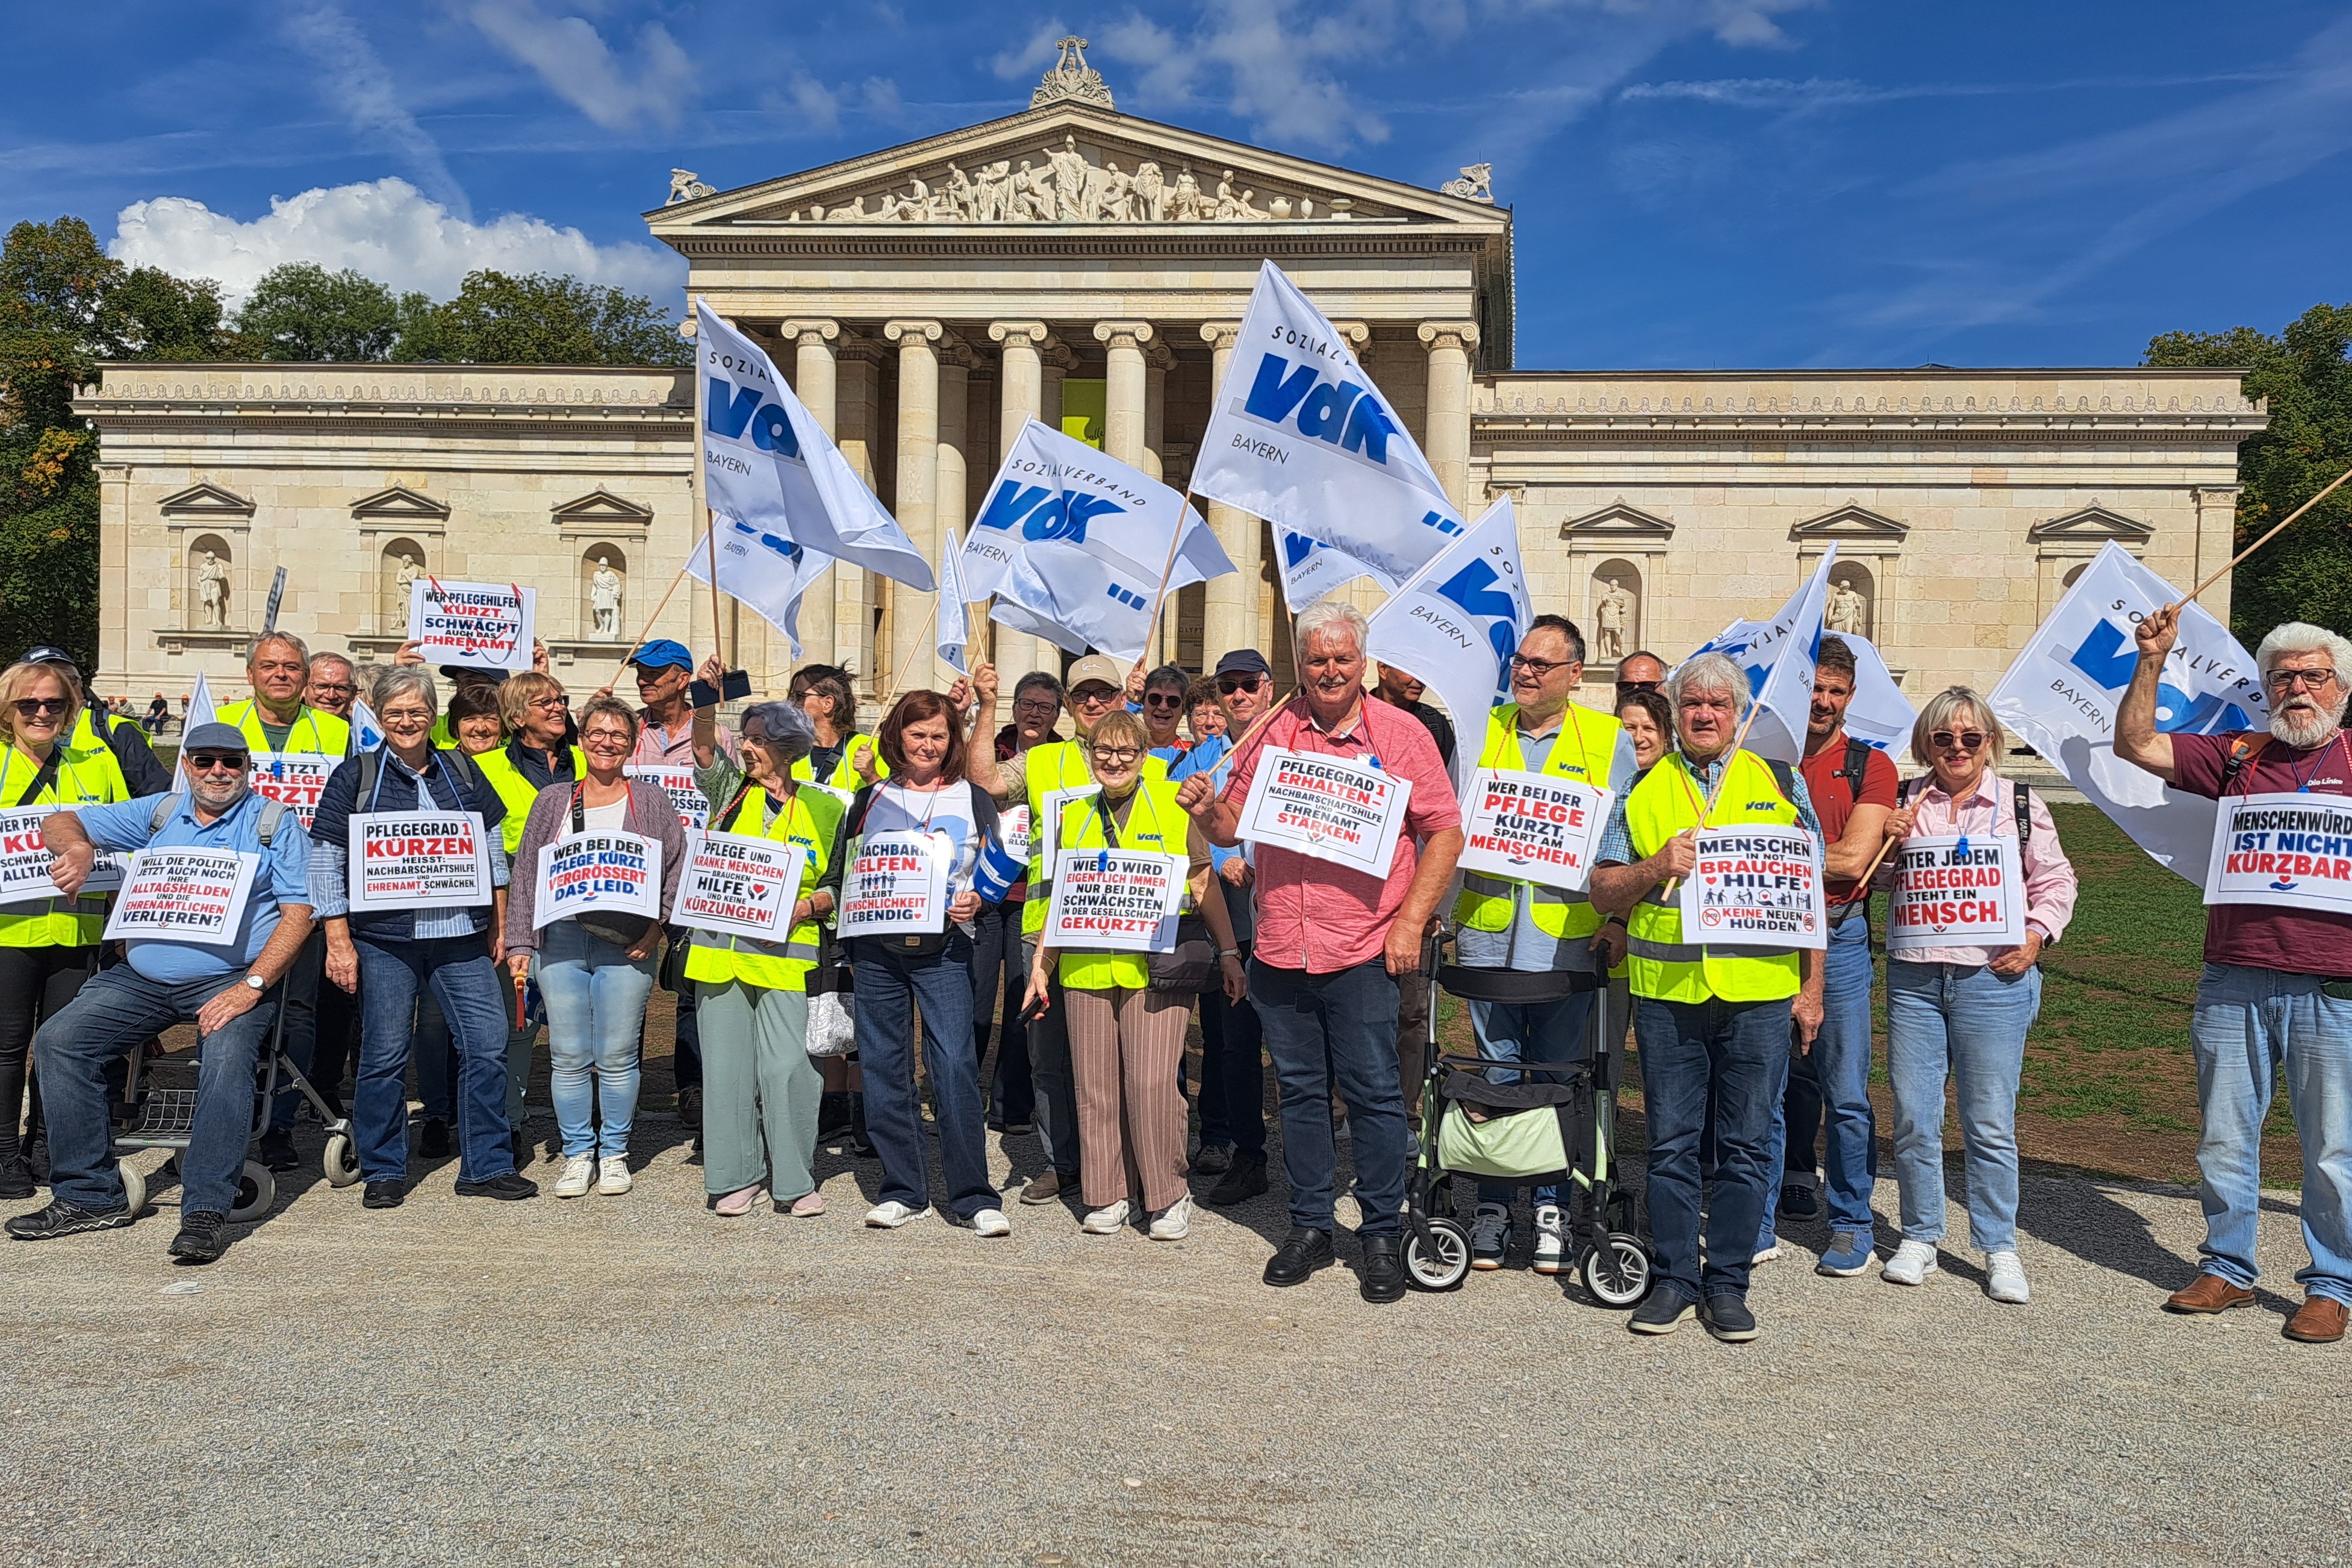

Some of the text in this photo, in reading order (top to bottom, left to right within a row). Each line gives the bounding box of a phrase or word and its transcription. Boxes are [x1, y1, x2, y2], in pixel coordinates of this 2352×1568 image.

[1231, 433, 1289, 465] BAYERN
[708, 450, 752, 477] BAYERN
[1012, 459, 1146, 506] SOZIALVERBAND
[966, 542, 1013, 564] BAYERN
[1290, 558, 1324, 585] BAYERN
[426, 591, 521, 608] WER PFLEGEHILFEN
[443, 604, 505, 618] KÜRZT.
[425, 617, 518, 634] SCHWÄCHT
[1409, 606, 1473, 649] BAYERN
[423, 635, 518, 651] EHRENAMT.
[2050, 679, 2112, 734] BAYERN
[1558, 762, 1587, 775] VdK
[664, 775, 696, 789] HIL
[1279, 760, 1385, 797] PFLEGEGRAD 1
[1277, 772, 1370, 805] ERHALTEN
[1487, 780, 1581, 808] WER BEI DER
[1268, 786, 1383, 823] NACHBARSCHAFTSHILFE
[1484, 794, 1585, 828] PFLEGE
[1746, 801, 1778, 811] VdK
[1284, 803, 1360, 830] EHRENAMT
[2232, 809, 2352, 835] MENSCHENWÜRD
[366, 823, 471, 838] PFLEGEGRAD 1
[1275, 812, 1361, 845] STÄRKEN!
[1495, 814, 1565, 840] KÜRZT,
[1492, 827, 1563, 849] SPART AM
[2233, 832, 2352, 857] IST NICHT
[366, 837, 474, 858] KÜRZEN
[553, 838, 644, 862] WER BEI DER
[703, 842, 772, 864] PFLEGE UND
[1469, 834, 1581, 869] MENSCHEN.
[1699, 838, 1810, 857] MENSCHEN
[0, 853, 56, 868] SCHWÄCH
[142, 856, 238, 871] WILL DIE POLITIK
[549, 850, 647, 878] PFLEGE KÜRZT,
[852, 857, 922, 874] HELFEN,
[1941, 849, 1999, 866] JEDEM
[2226, 848, 2352, 881] KÜRZBAR
[137, 866, 235, 880] JETZT AUCH NOCH
[367, 864, 475, 876] NACHBARSCHAFTSHILFE
[694, 855, 785, 879] KRANKE MENSCHEN
[712, 870, 751, 882] BRAUCHEN
[1073, 860, 1163, 875] WIEO WIRD
[1699, 860, 1812, 878] BRAUCHEN
[367, 878, 476, 892] EHRENAMT SCHWÄCHEN.
[549, 863, 647, 891] VERGRÖSSERT
[697, 876, 744, 896] HILFE
[1066, 873, 1166, 888] EIGENTLICH IMMER
[1723, 874, 1800, 891] HILFE
[1894, 867, 2001, 893] PFLEGEGRAD
[131, 882, 231, 898] ALLTAGSHELDEN
[554, 880, 639, 903] DAS LEID.
[707, 892, 747, 905] UND KEINE
[862, 890, 894, 899] BLEIBT
[1076, 883, 1155, 897] NUR BEI DEN
[1906, 889, 1977, 903] STEHT EIN
[125, 900, 226, 915] EHRENAMTLICHEN
[685, 895, 774, 923] KÜRZUNGEN!
[845, 897, 927, 913] MENSCHLICHKEIT
[1063, 894, 1163, 911] SCHWÄCHSTEN
[123, 910, 223, 927] VERLIEREN?
[847, 909, 914, 924] LEBENDIG
[1072, 907, 1088, 915] DER
[1090, 907, 1162, 921] GESELLSCHAFT
[1722, 908, 1803, 921] KEINE NEUEN
[1894, 900, 2003, 927] MENSCH.
[1061, 916, 1160, 934] GEKÜRZT?
[1729, 917, 1800, 933] HÜRDEN.
